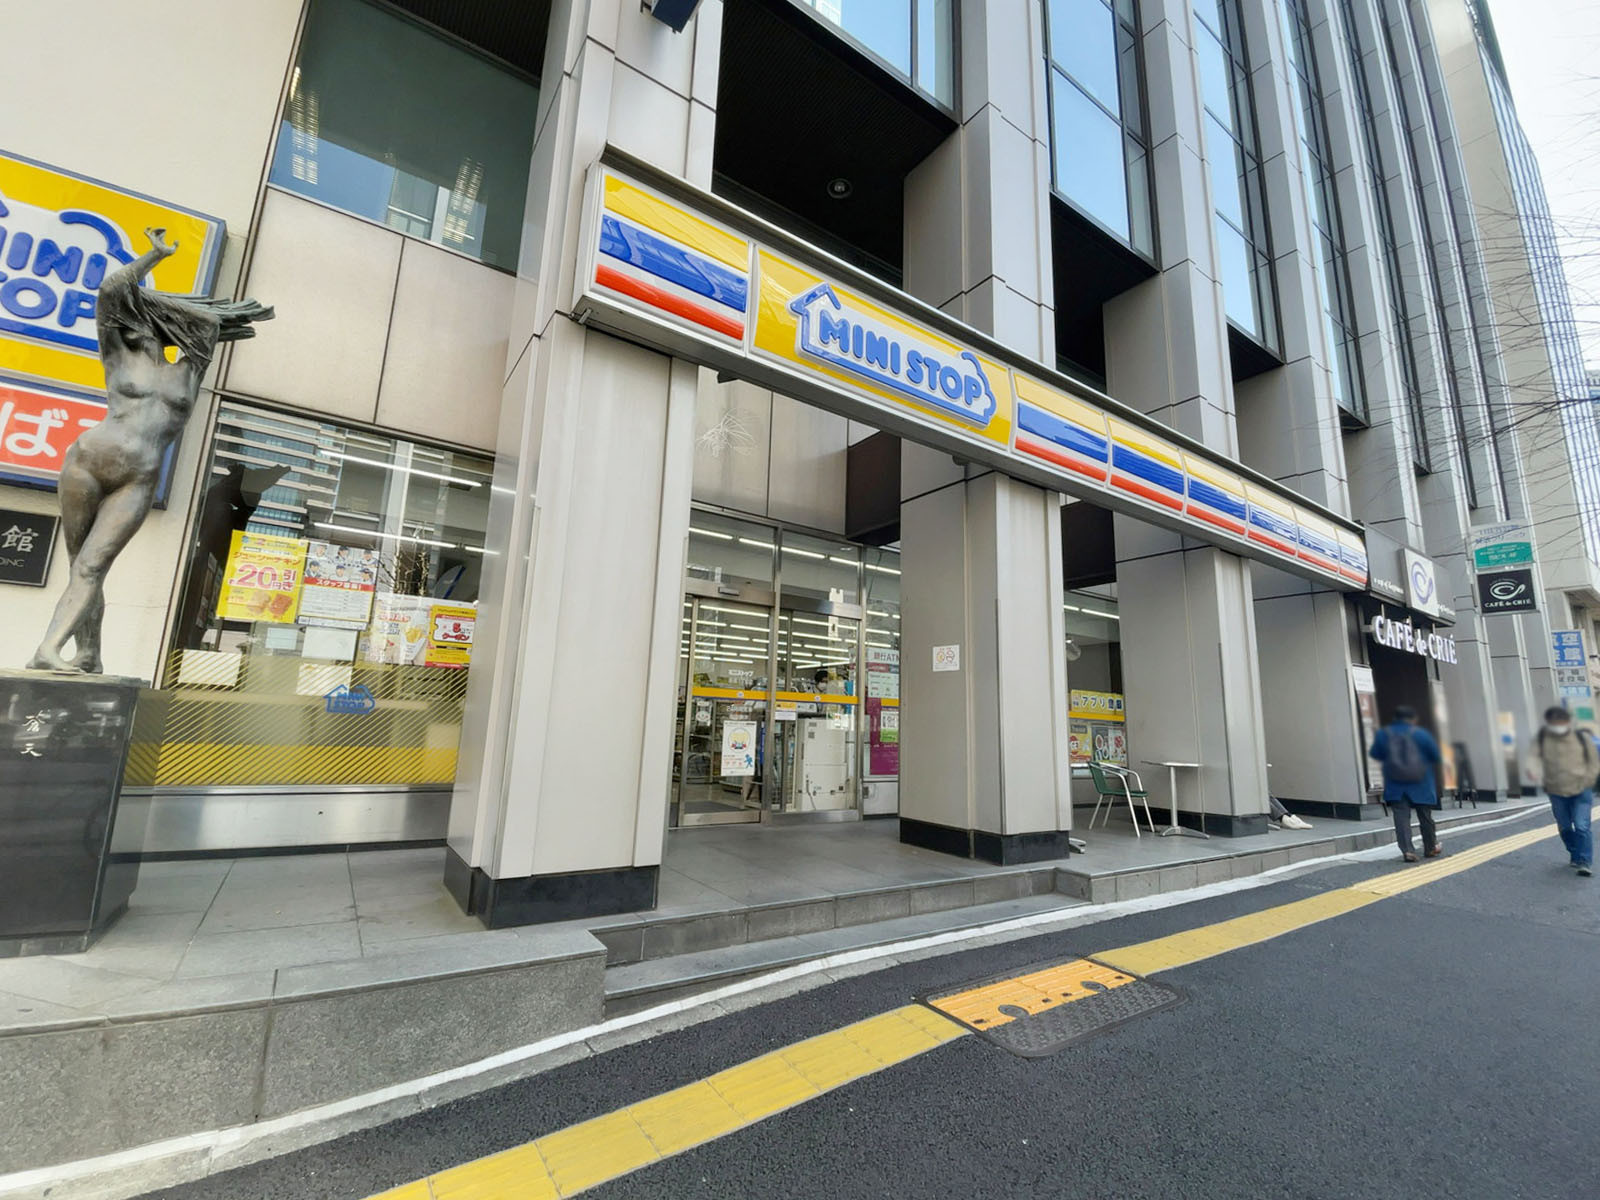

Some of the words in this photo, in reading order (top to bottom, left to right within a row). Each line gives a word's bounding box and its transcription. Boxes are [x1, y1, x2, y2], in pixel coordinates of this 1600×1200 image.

[819, 310, 901, 375] MINI
[907, 350, 982, 406] STOP
[1, 525, 39, 552] 館
